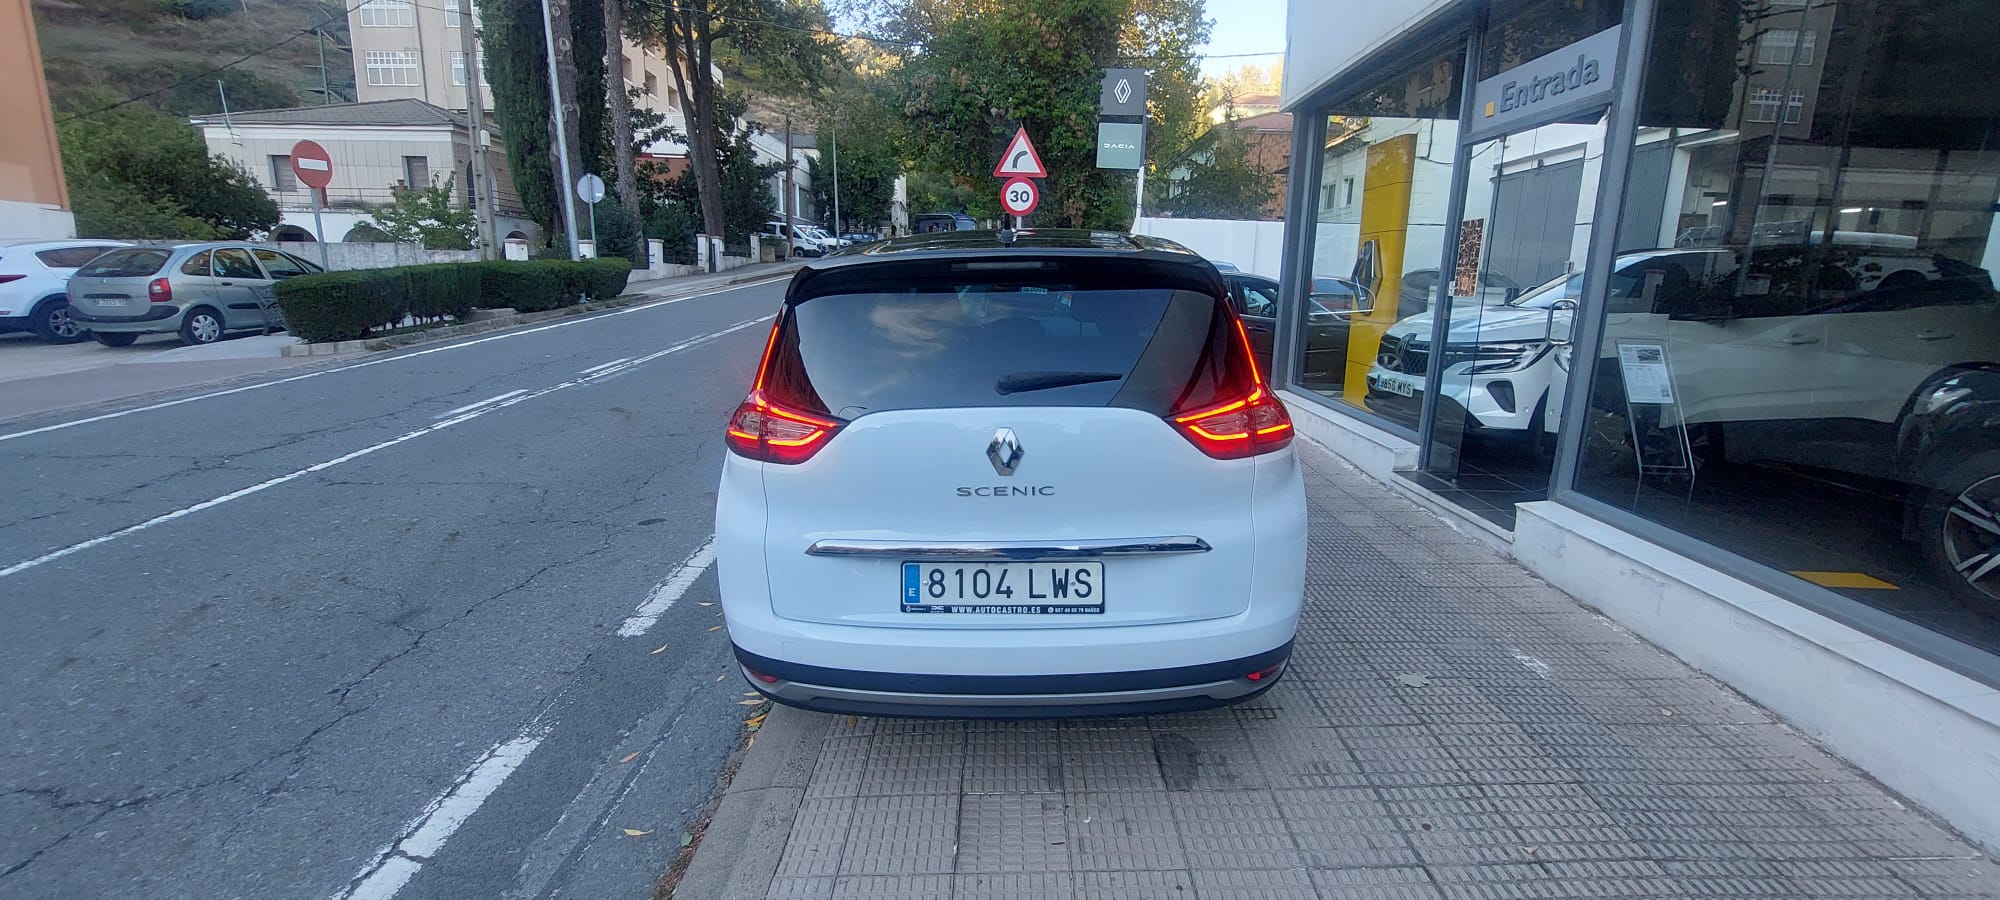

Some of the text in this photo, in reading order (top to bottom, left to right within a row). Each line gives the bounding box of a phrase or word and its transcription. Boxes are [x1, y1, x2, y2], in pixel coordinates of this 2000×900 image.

[1500, 54, 1600, 113] Entrada
[1009, 190, 1030, 203] 30
[956, 486, 1055, 496] SCENIC
[908, 568, 1093, 599] E 8104 LWS
[951, 606, 1041, 614] WWW.AUTOCASTRO.ES
